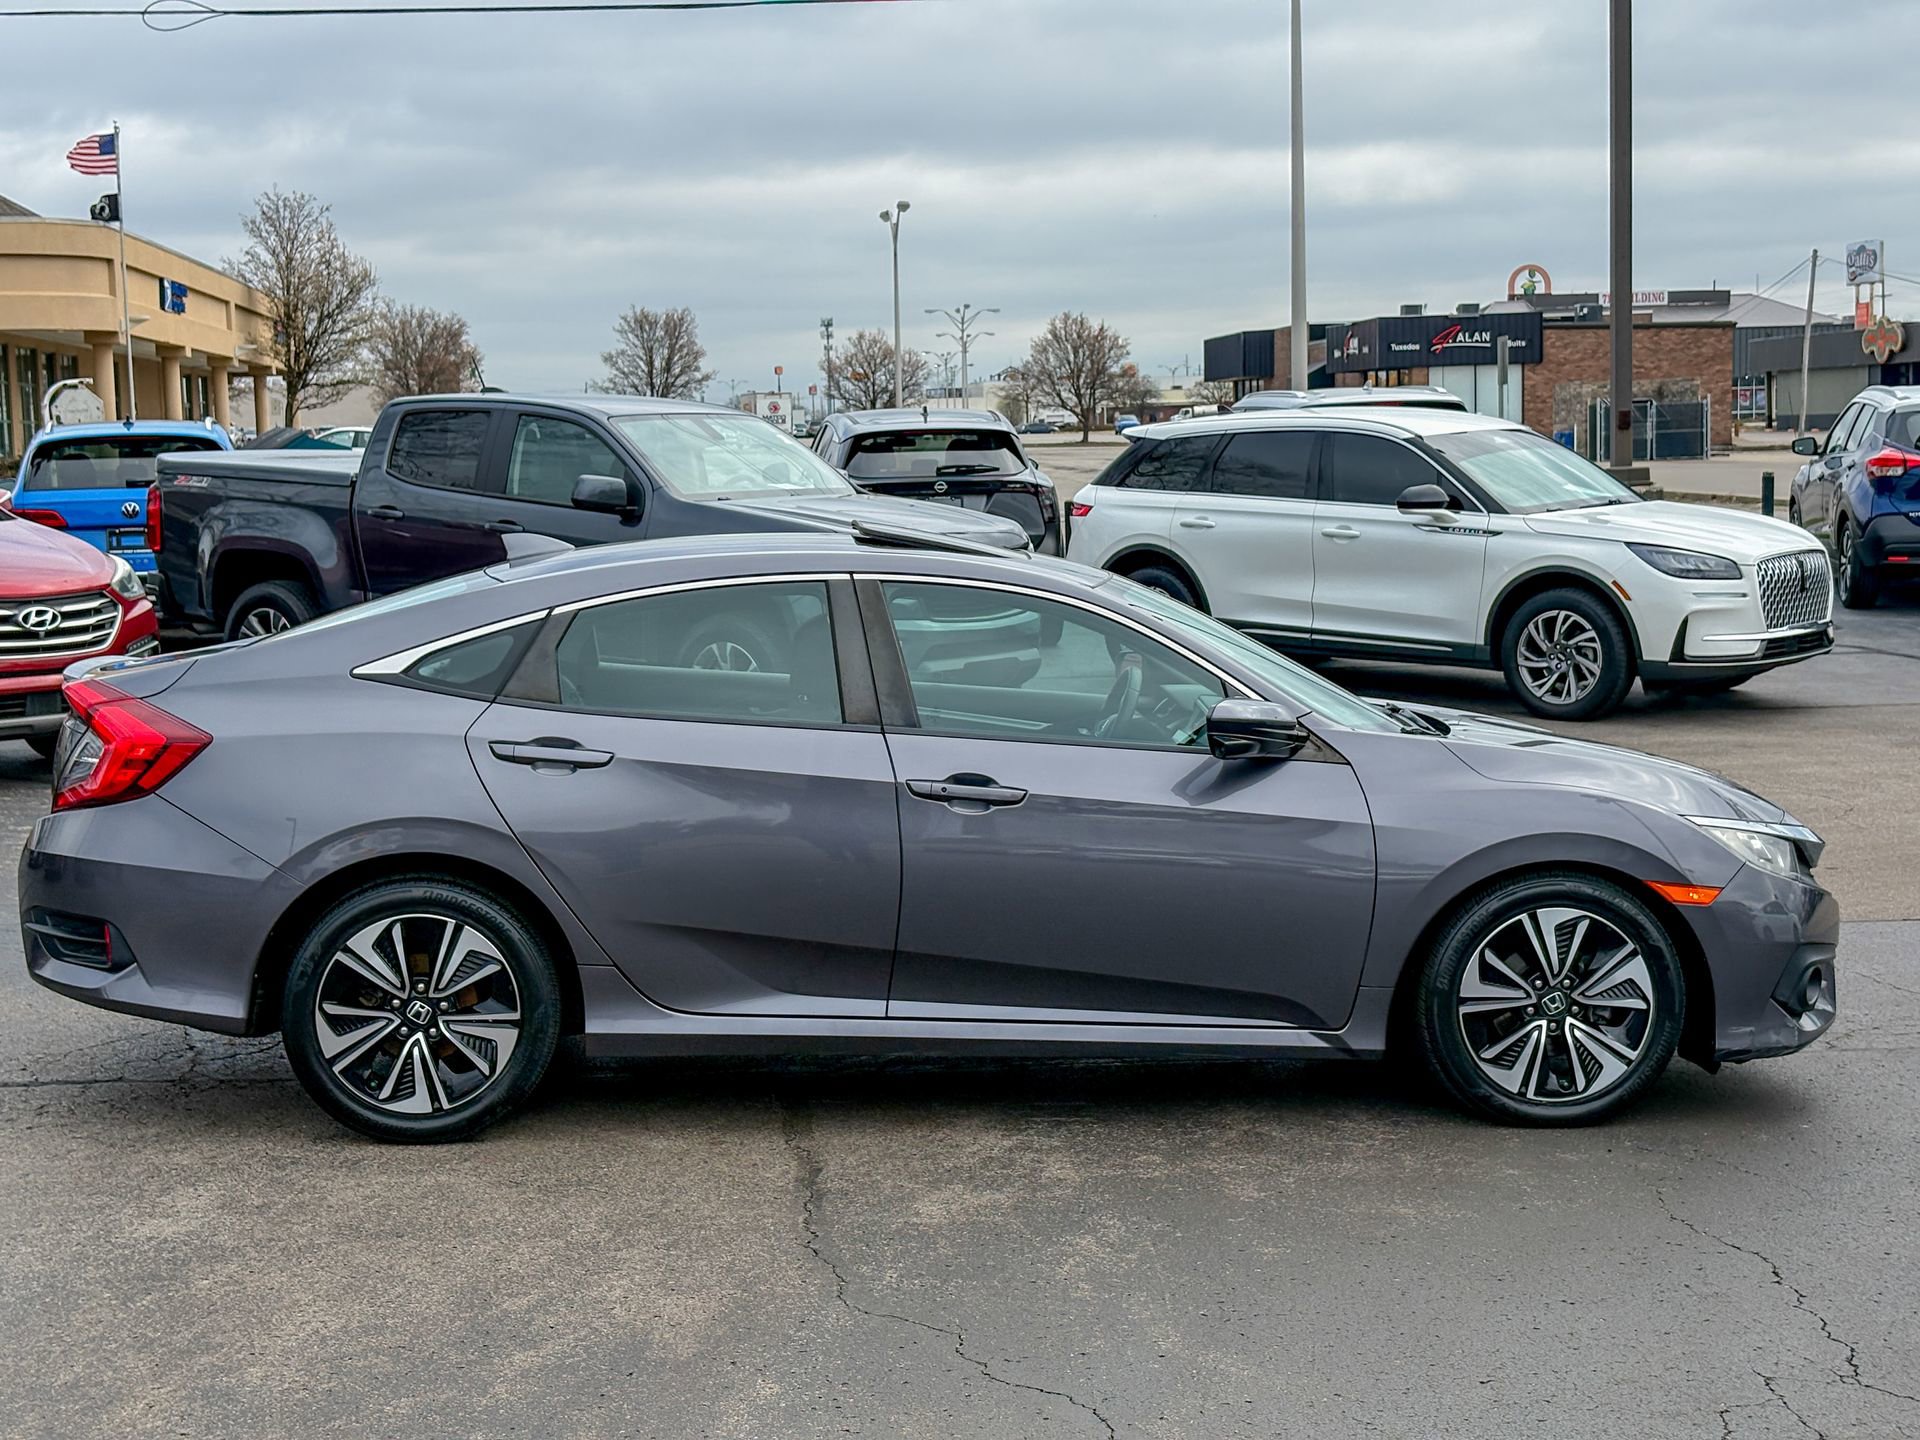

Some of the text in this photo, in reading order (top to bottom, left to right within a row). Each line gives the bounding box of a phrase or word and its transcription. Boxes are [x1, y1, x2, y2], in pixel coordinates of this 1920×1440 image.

[1390, 343, 1420, 352] Tuxedos
[1456, 331, 1491, 343] ALAN
[422, 889, 513, 935] BRIDGESTONE
[1436, 907, 1494, 991] BRIDGESTONE
